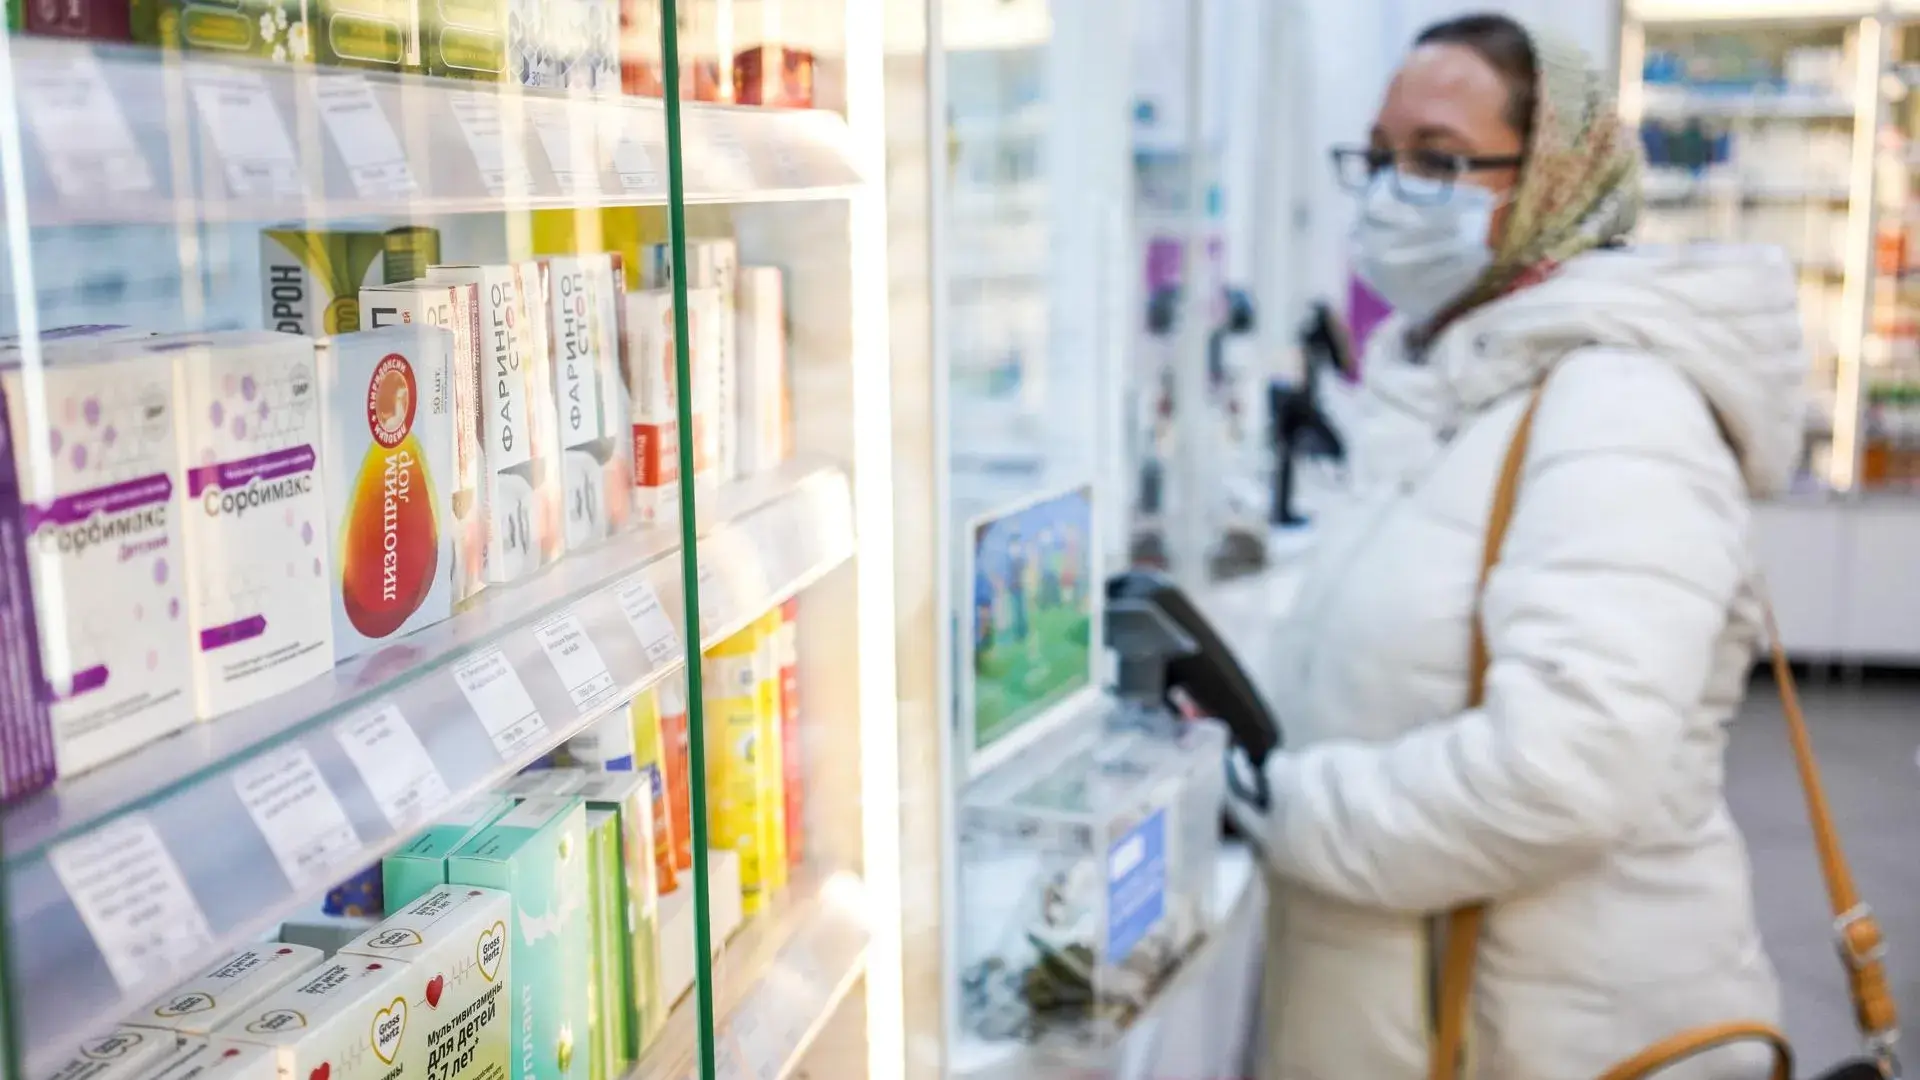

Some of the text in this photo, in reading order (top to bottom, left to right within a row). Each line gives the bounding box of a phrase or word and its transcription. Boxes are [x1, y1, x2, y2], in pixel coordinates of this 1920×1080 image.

[502, 281, 519, 371] СТОП
[573, 273, 589, 356] СТОП
[491, 283, 514, 452] ФАРИНГО
[561, 275, 582, 431] ФАРИНГО
[204, 474, 312, 518] Сорбимакс
[397, 450, 414, 503] ЛОР
[383, 453, 399, 601] ЛИЗОПРИМ
[481, 935, 500, 955] Gross
[483, 946, 500, 966] Hertz
[378, 1014, 401, 1035] Gross
[379, 1025, 400, 1047] Hertz
[427, 980, 503, 1047] Мультивитамины
[427, 1036, 454, 1076] для
[457, 997, 496, 1052] детей
